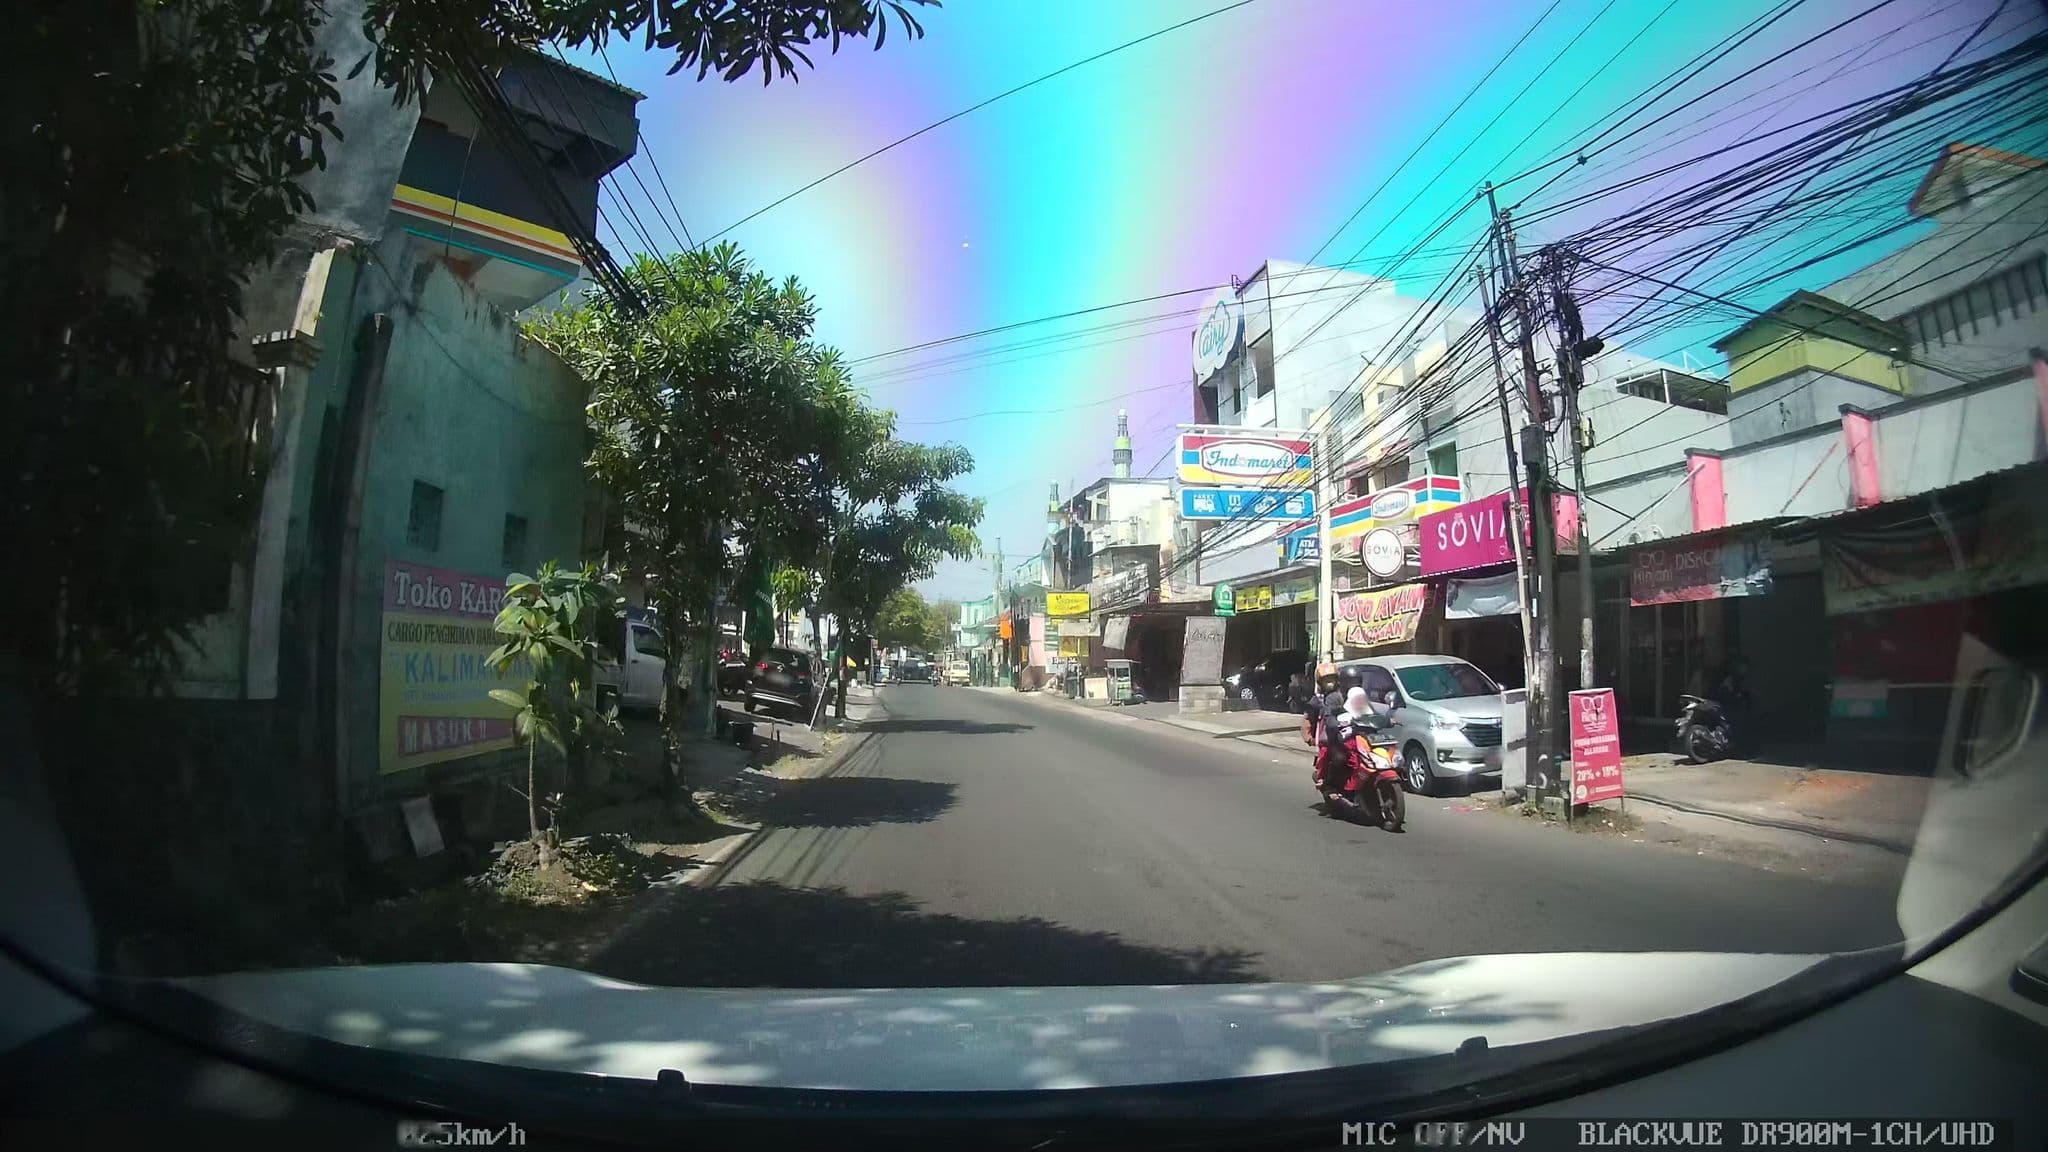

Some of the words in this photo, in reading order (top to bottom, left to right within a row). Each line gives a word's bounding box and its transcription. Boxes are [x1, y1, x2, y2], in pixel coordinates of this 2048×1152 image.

[395, 569, 453, 611] Toko
[459, 582, 505, 615] KAR
[404, 720, 472, 753] MASUK
